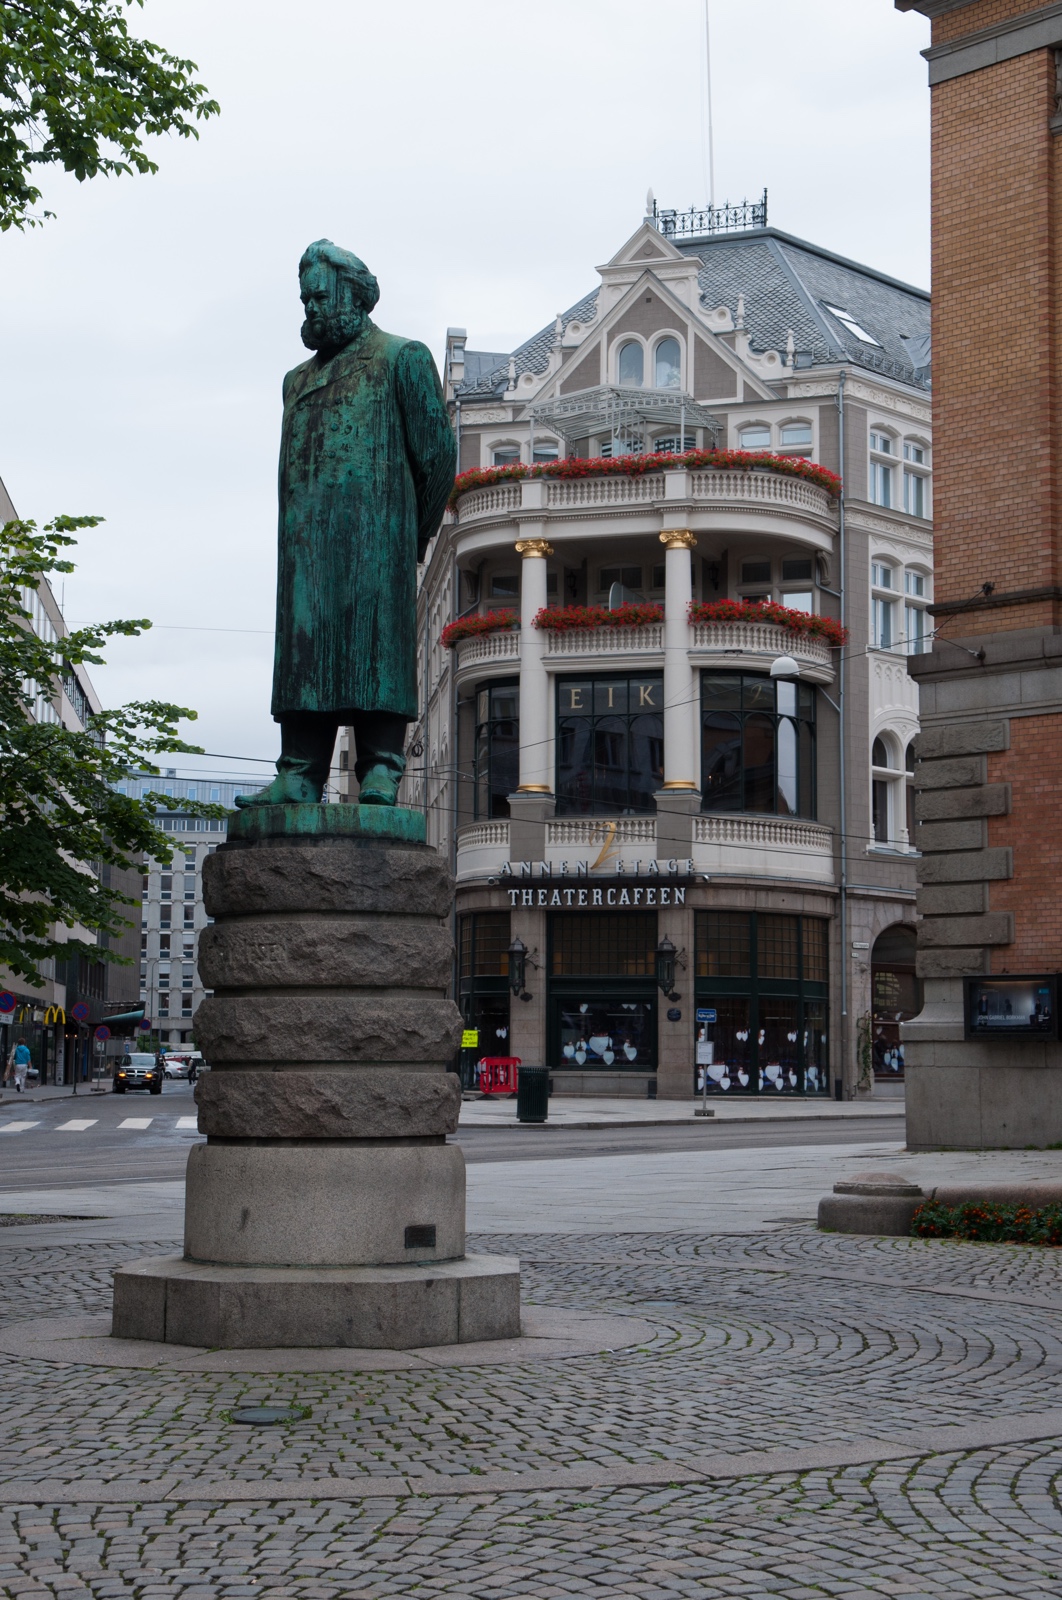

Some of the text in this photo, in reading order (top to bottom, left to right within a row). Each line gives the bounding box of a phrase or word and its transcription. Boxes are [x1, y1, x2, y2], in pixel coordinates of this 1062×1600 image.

[570, 686, 656, 709] EIK
[500, 821, 695, 874] ANNEN 2 ETAGE
[507, 887, 686, 906] THEATERCAFEEN
